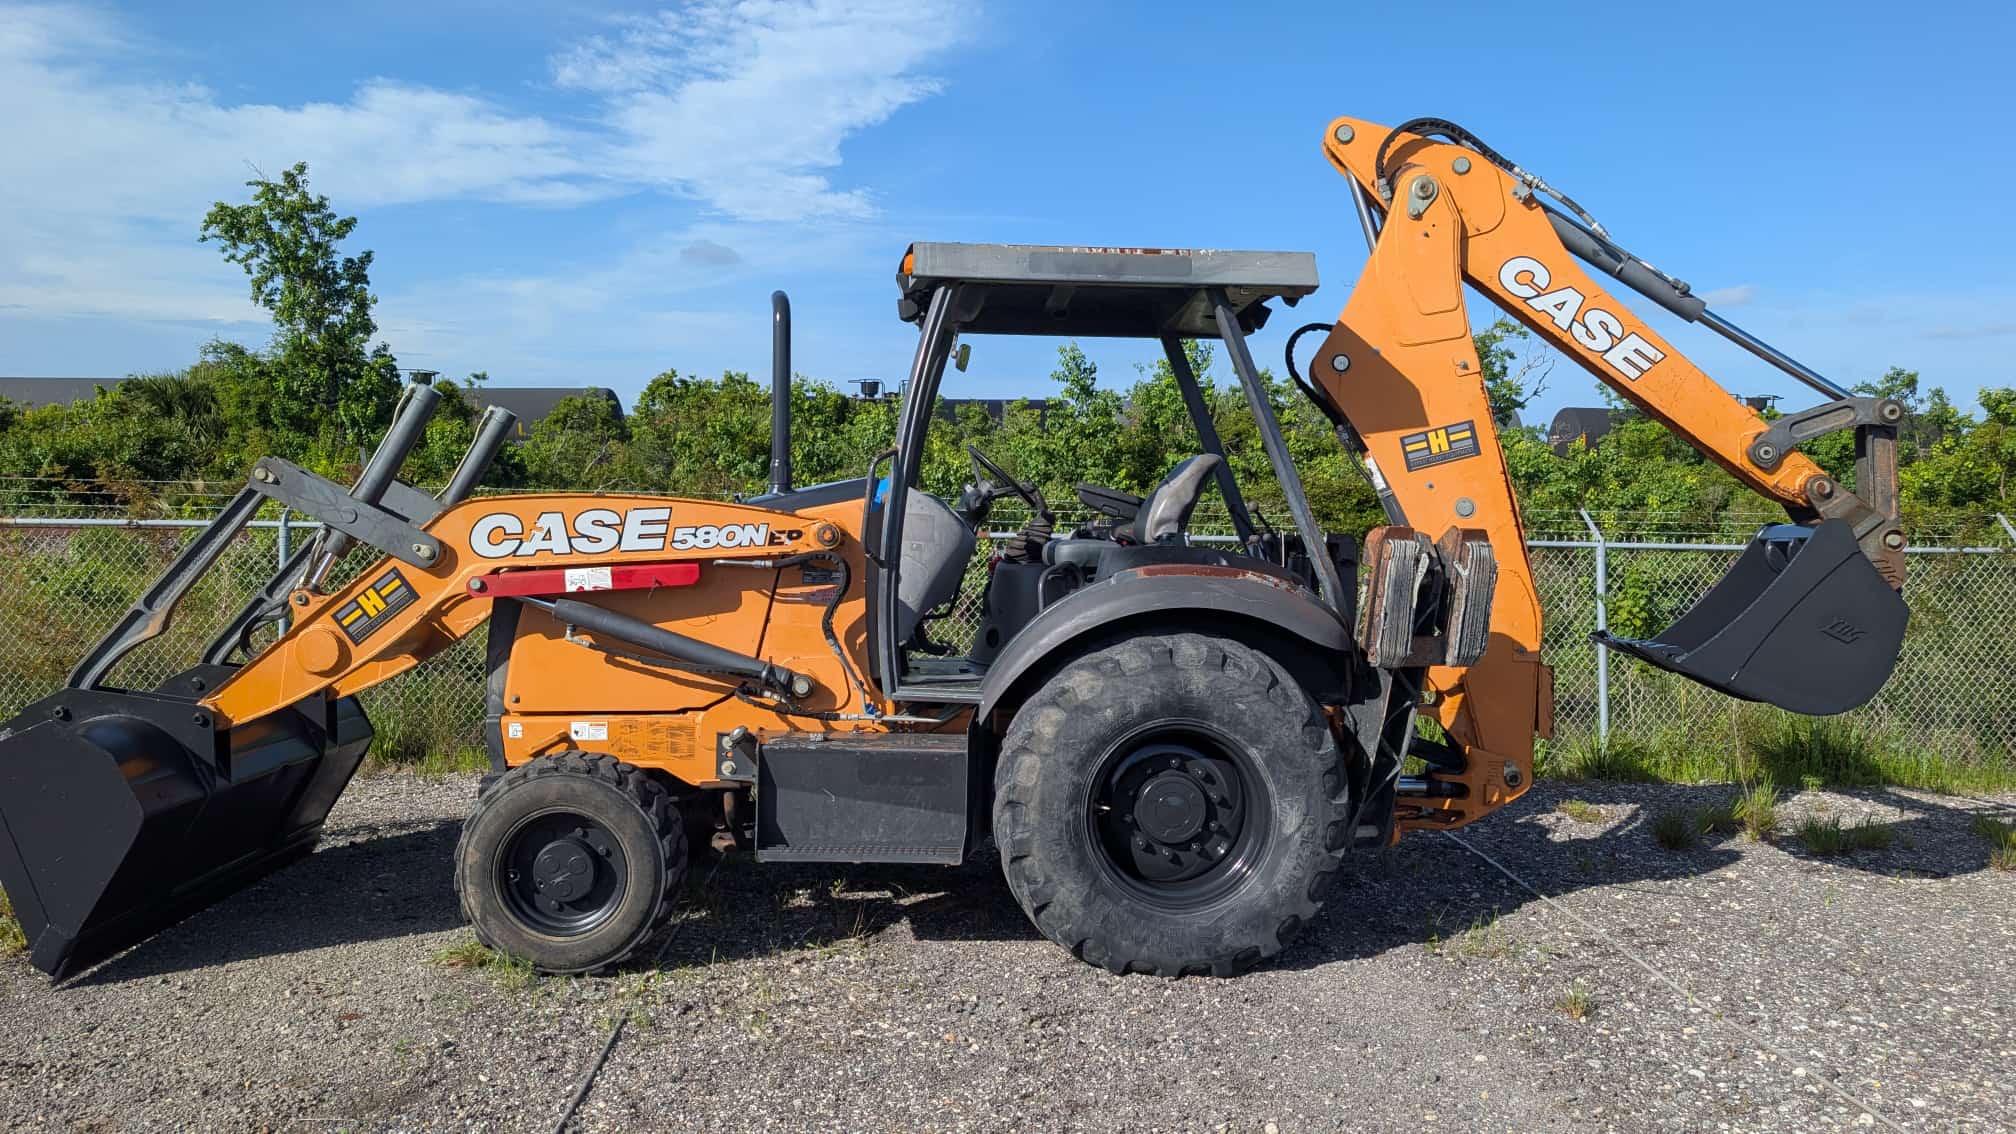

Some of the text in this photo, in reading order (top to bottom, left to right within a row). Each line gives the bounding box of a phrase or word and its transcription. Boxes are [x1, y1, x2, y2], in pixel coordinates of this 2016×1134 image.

[1498, 256, 1667, 382] CASE
[469, 507, 672, 559] CASE
[672, 523, 769, 550] 580N
